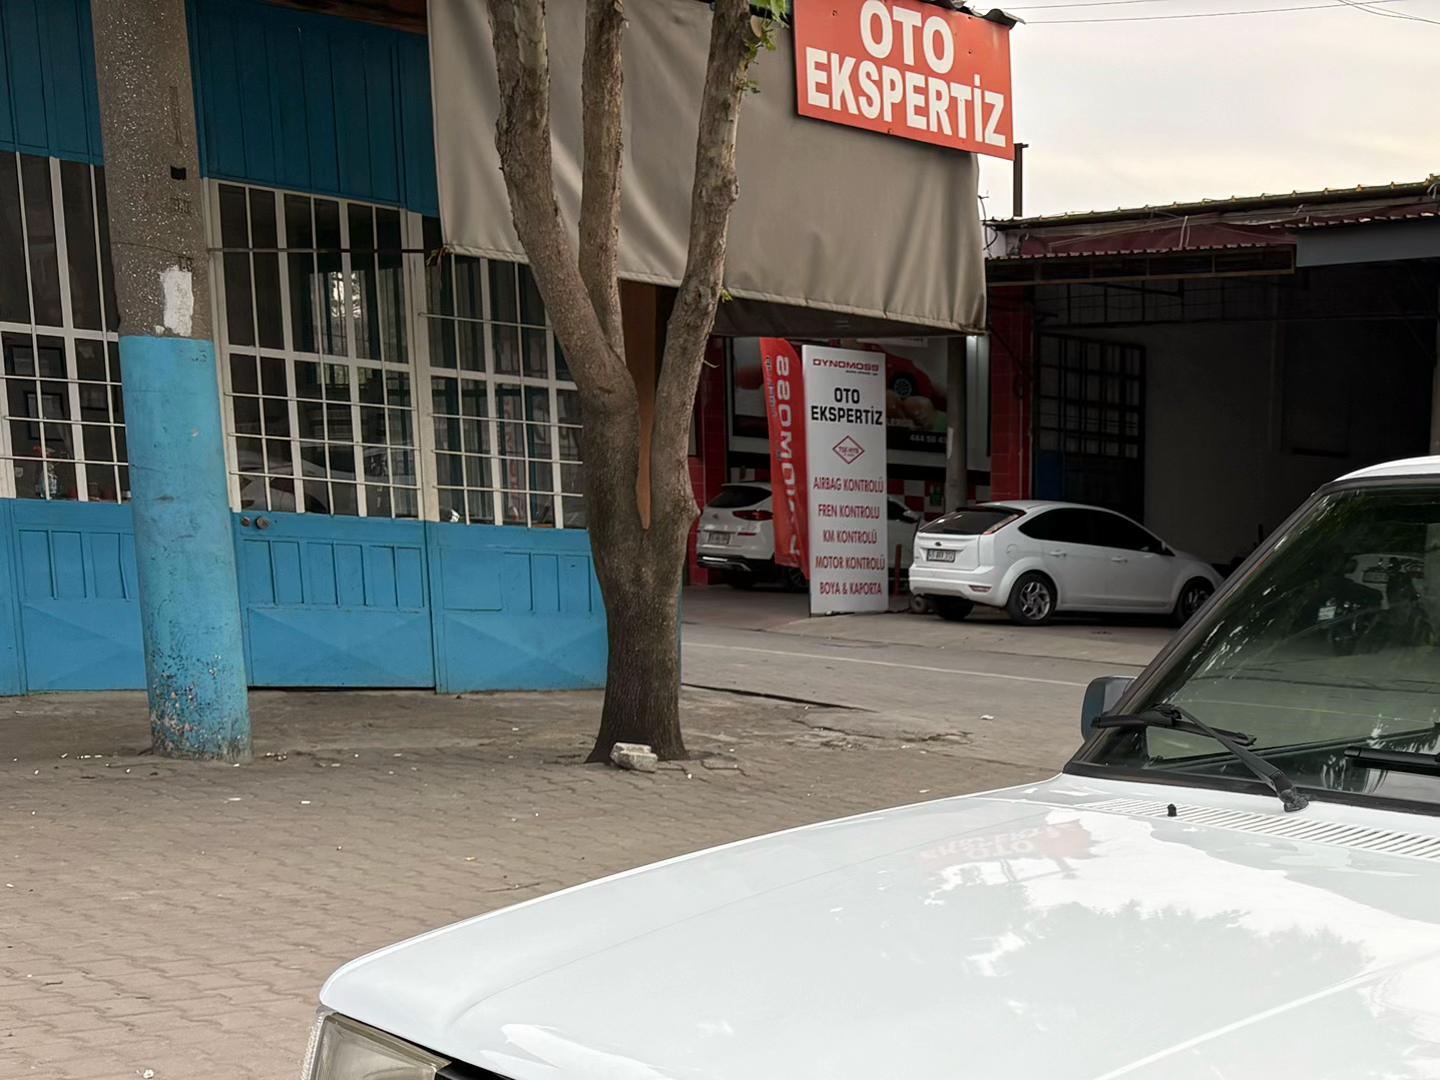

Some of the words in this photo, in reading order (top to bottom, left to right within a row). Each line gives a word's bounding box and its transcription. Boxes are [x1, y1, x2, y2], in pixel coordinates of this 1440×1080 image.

[860, 0, 954, 74] OTO
[805, 46, 1006, 148] EKSPERTİZ
[812, 358, 880, 373] DYNOMOSS
[834, 387, 861, 404] OTO
[811, 405, 883, 426] EKSPERTİZ
[813, 477, 842, 491] AIRBAG
[818, 504, 838, 517] FREN
[823, 530, 835, 543] KM
[815, 555, 844, 569] MOTOR
[819, 583, 841, 595] BOYA
[842, 584, 848, 595] &
[849, 582, 882, 596] KAPORTA
